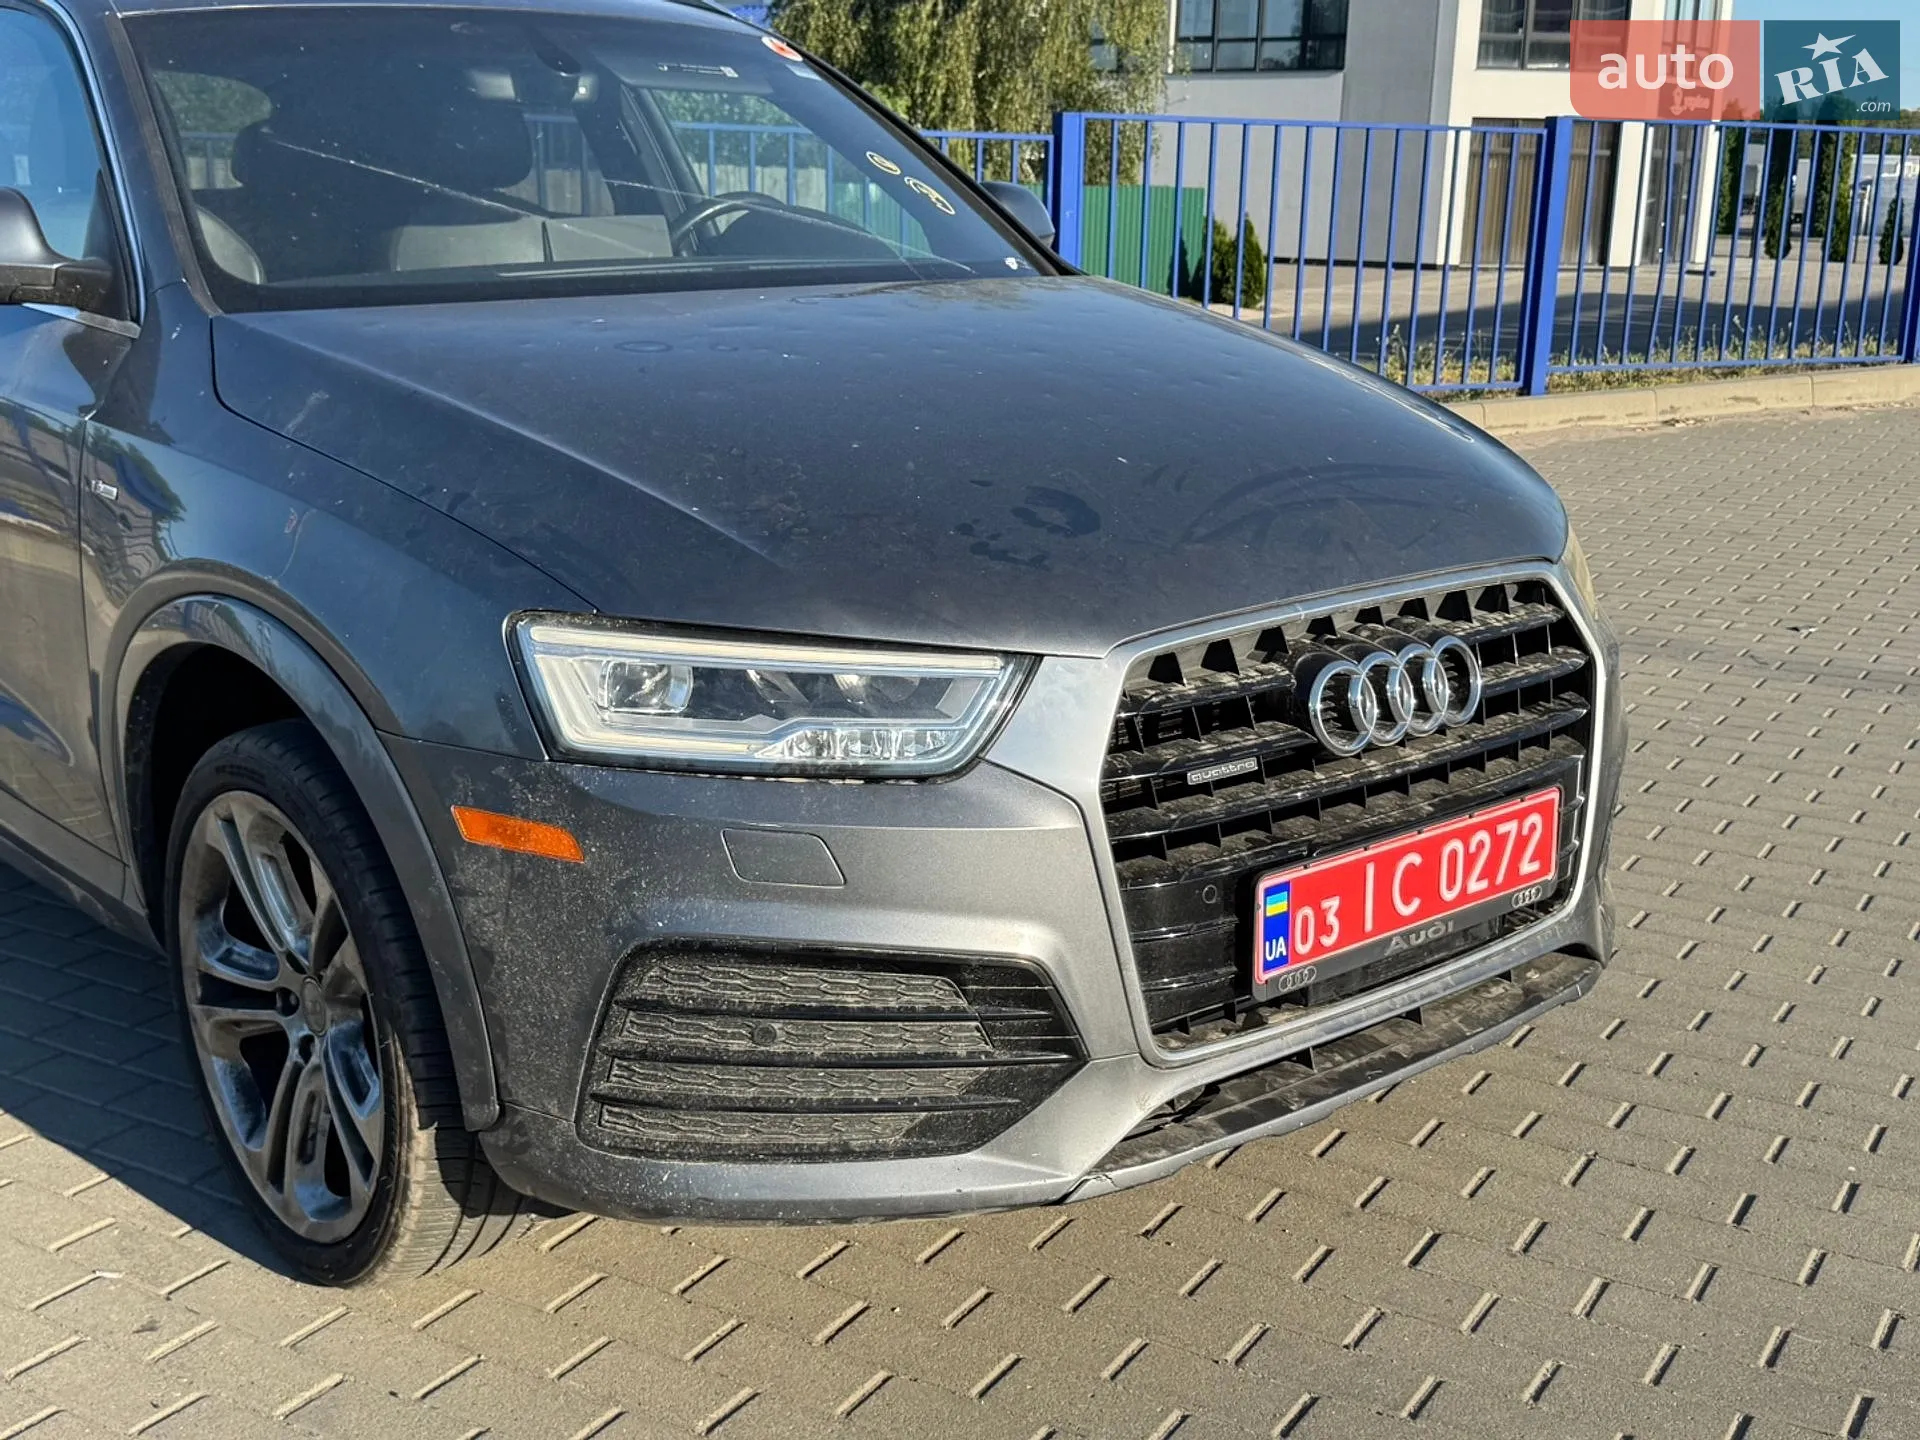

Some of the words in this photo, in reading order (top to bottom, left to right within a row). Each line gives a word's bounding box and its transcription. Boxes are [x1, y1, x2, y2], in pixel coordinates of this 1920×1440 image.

[1190, 760, 1256, 782] quattro
[1294, 895, 1341, 955] 03
[1363, 851, 1424, 933] IC
[1439, 812, 1544, 902] 0272
[1265, 936, 1287, 961] UA
[1383, 919, 1454, 957] Audi
